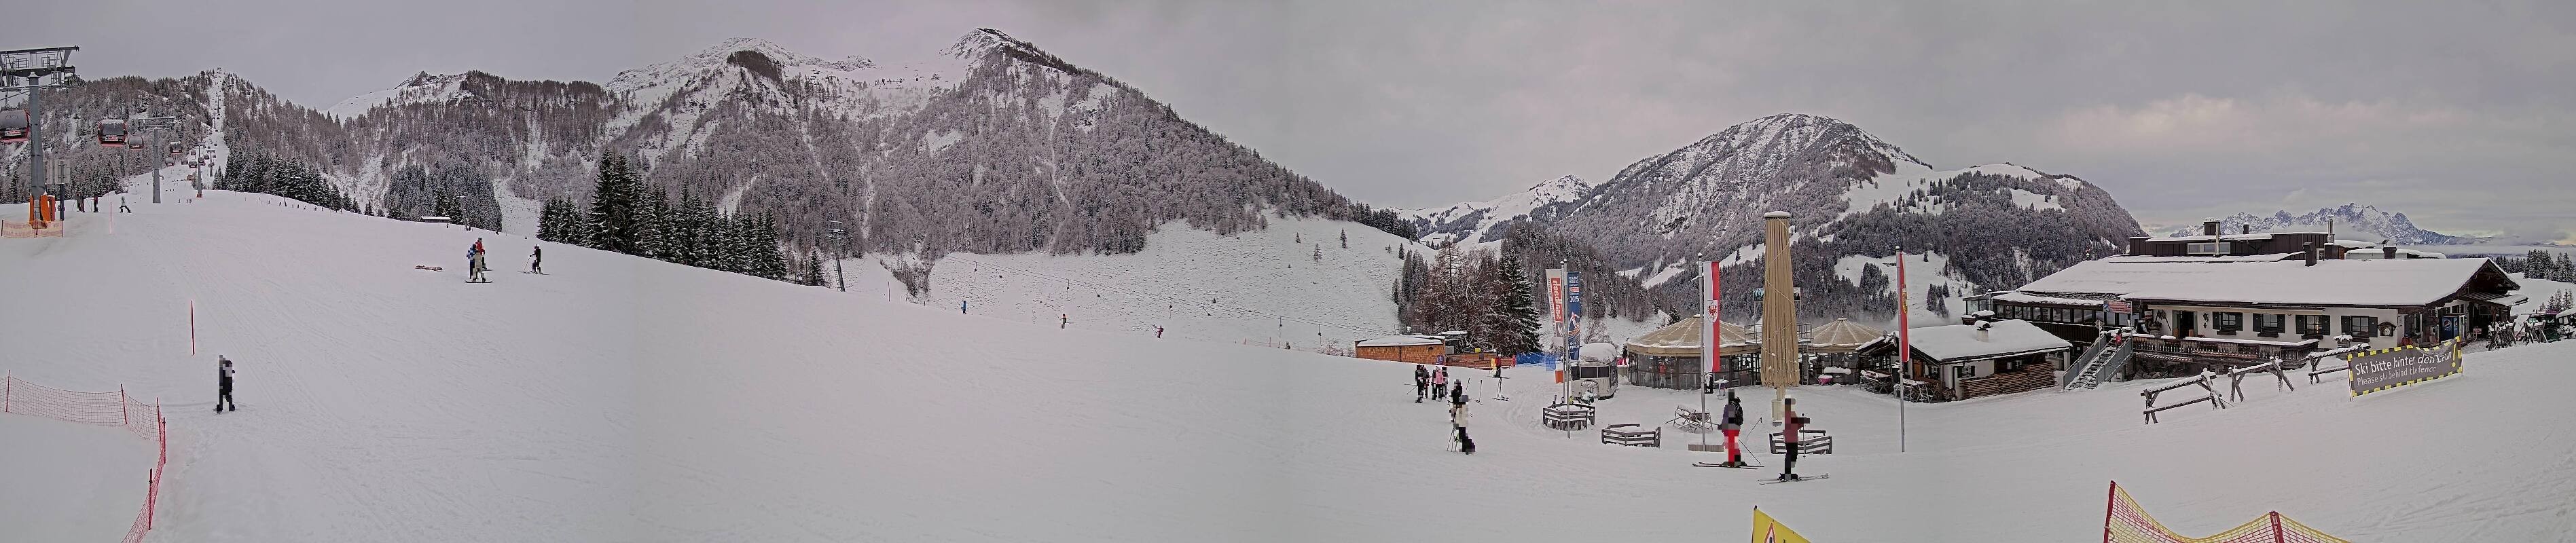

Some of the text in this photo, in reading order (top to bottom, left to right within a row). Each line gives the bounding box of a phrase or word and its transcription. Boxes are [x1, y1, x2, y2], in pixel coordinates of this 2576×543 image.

[1570, 294, 1580, 303] 2015
[2355, 362, 2369, 375] Ski
[2370, 360, 2392, 373] bitte
[2393, 356, 2416, 368] hinter
[2417, 354, 2434, 364] den
[2357, 376, 2378, 386] Please
[2379, 372, 2387, 381] ski
[2389, 367, 2408, 379] behind
[2418, 364, 2437, 373] fence
